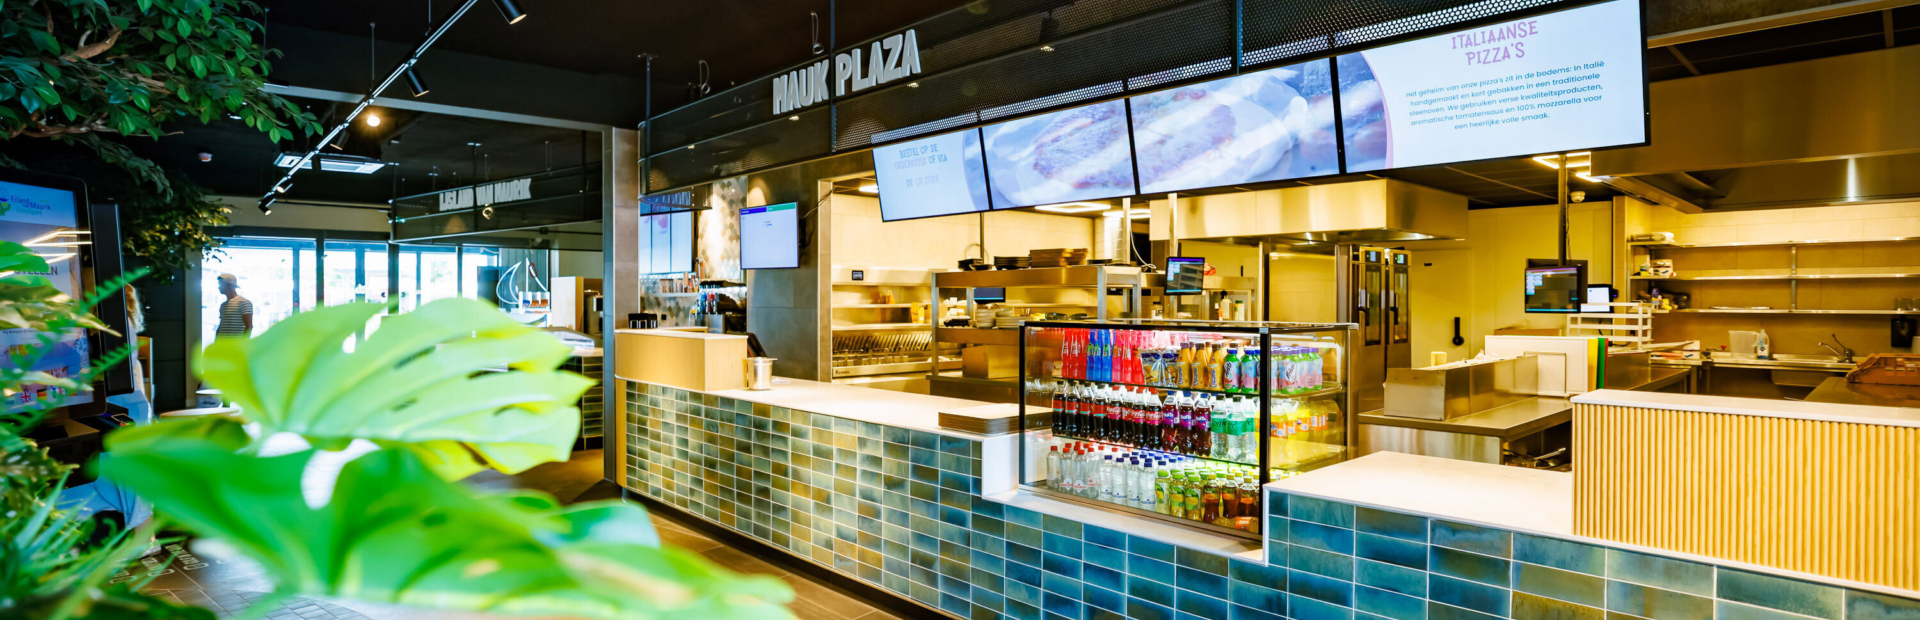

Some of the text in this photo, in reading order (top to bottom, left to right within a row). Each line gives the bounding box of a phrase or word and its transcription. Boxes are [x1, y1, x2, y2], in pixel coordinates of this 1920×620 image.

[1452, 20, 1538, 49] ITALIAANSE
[1465, 42, 1525, 66] PIZZA'S
[773, 29, 922, 115] MAUK PLAZA
[1418, 86, 1444, 97] geheim
[1480, 77, 1503, 87] pizza's
[1536, 67, 1572, 77] bodems:
[1584, 61, 1604, 69] Italië
[1409, 107, 1446, 116] steenoven.
[1460, 98, 1496, 110] gebruiken
[1521, 84, 1603, 100] kwaliteitsproducten,
[1410, 94, 1459, 106] handgemaakt
[1487, 85, 1524, 96] gebakken
[1552, 73, 1600, 85] traditionele
[1411, 115, 1454, 126] aromatische
[1456, 108, 1503, 119] tomatensaus
[1537, 98, 1581, 108] mozzarella
[1469, 119, 1500, 128] heerlijke
[1521, 112, 1550, 122] smaak.
[899, 144, 938, 158] BESTEL OP DE
[11, 196, 30, 204] Eiland
[30, 202, 51, 210] Maurik
[476, 184, 494, 206] VAN
[494, 178, 532, 203] MAURIK
